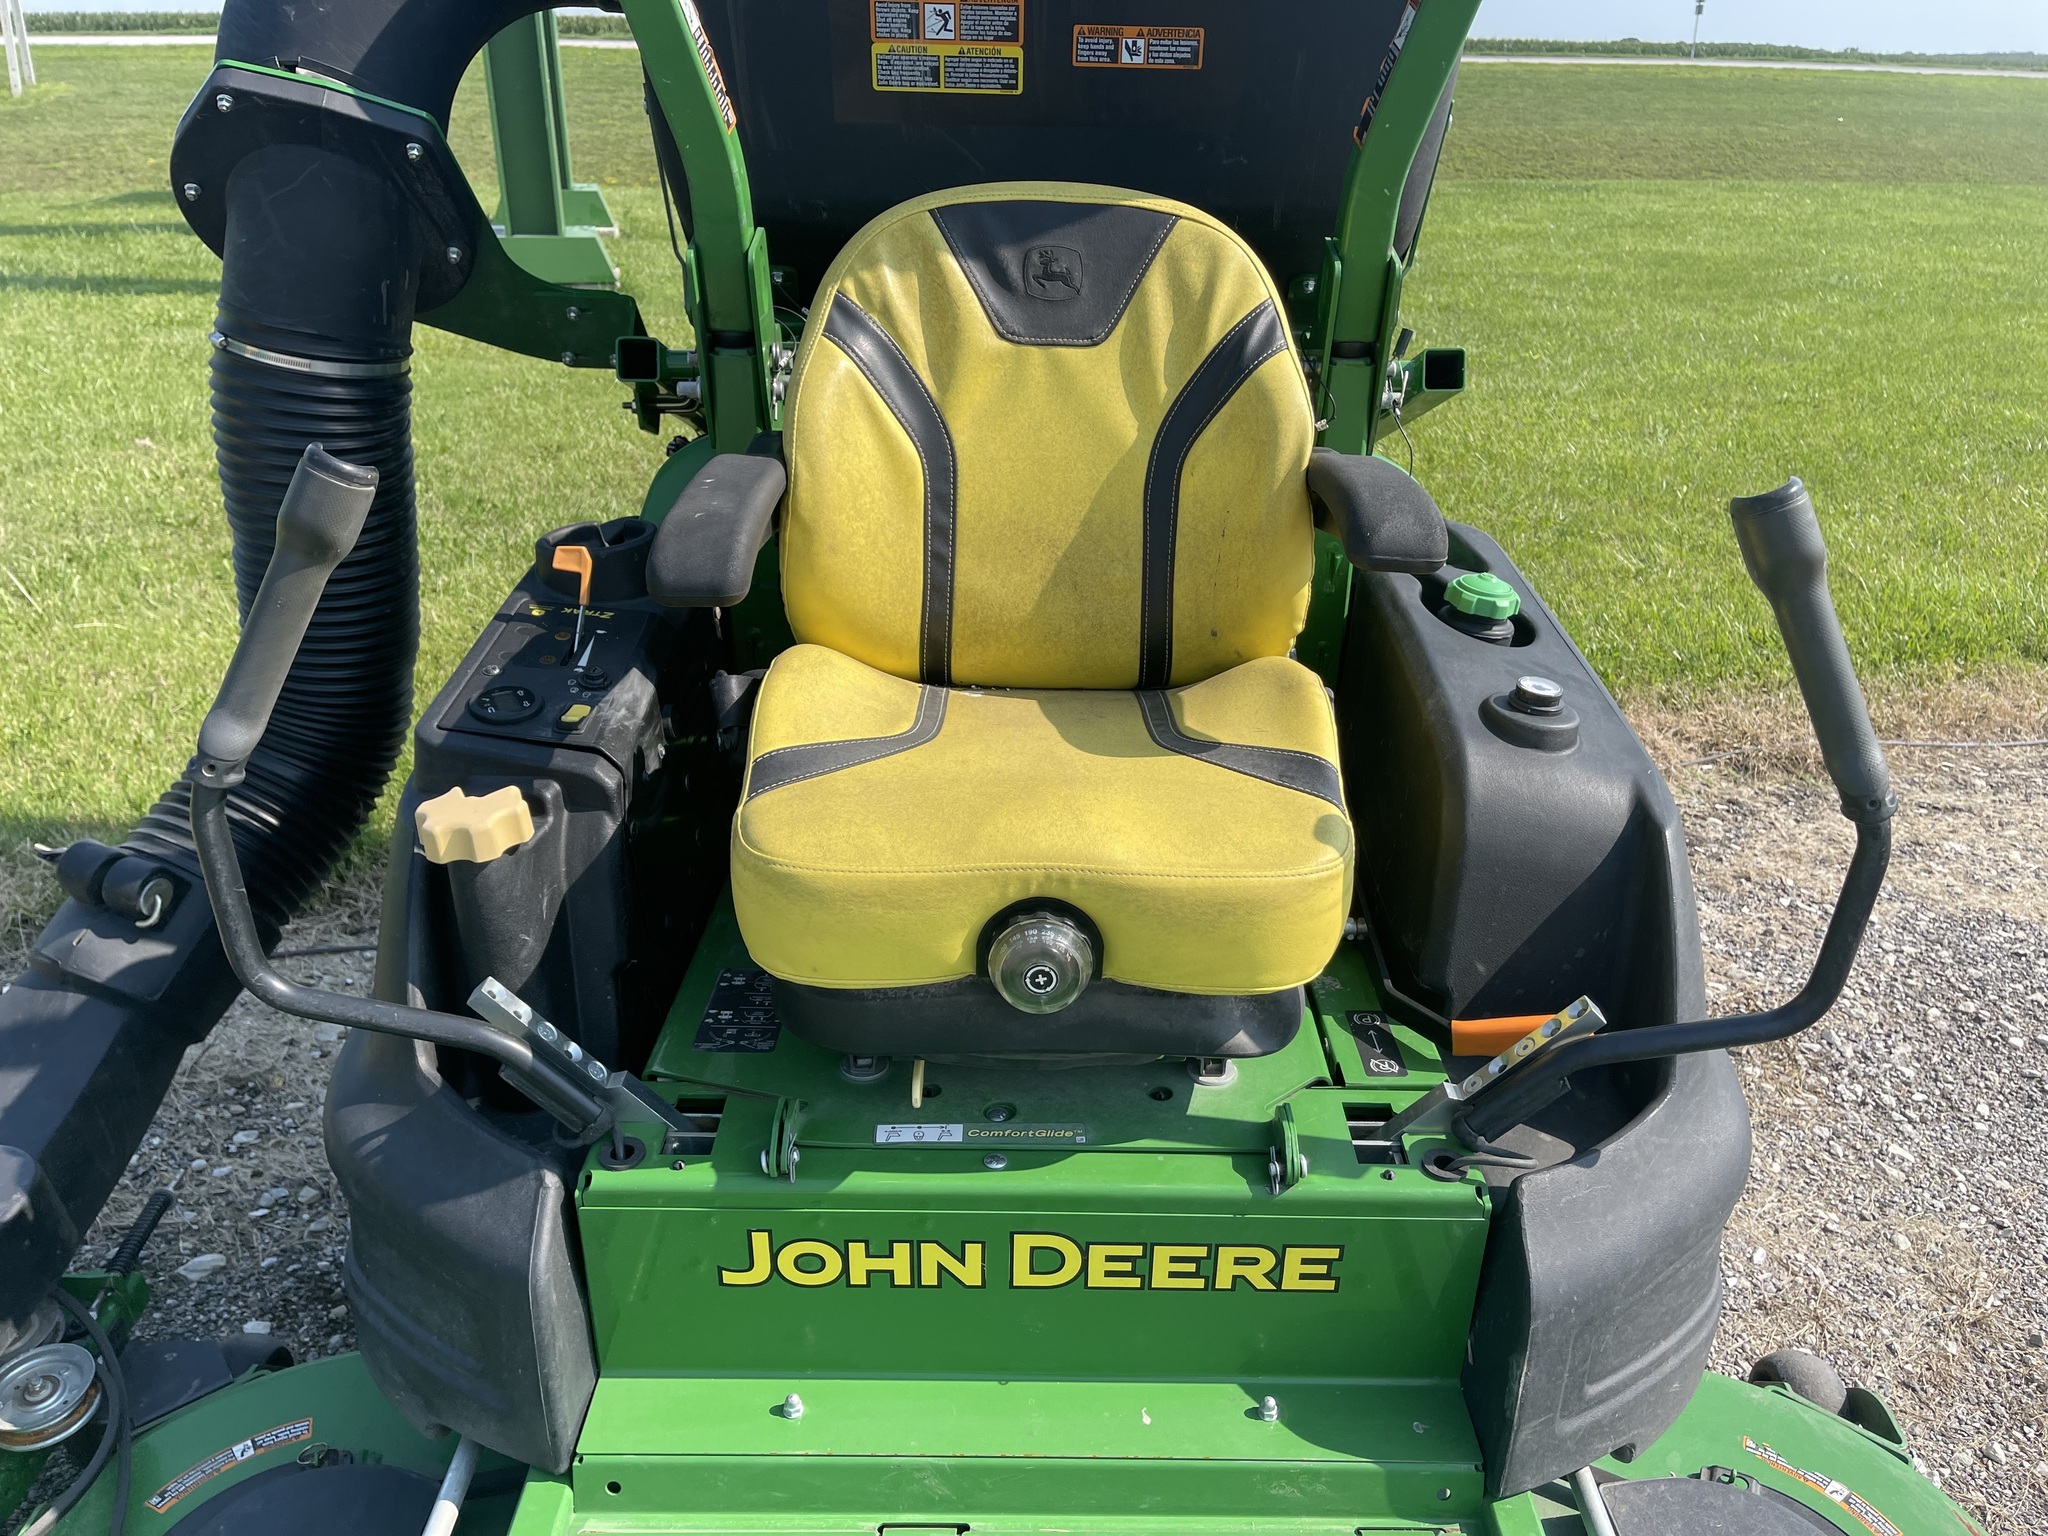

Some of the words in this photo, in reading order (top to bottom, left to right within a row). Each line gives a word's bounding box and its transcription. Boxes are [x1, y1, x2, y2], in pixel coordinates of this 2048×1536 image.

[1087, 26, 1124, 36] WARNING
[1146, 28, 1200, 38] ADVERTENCIA
[967, 46, 1001, 55] ATENCIÓN
[718, 1229, 987, 1289] JOHN
[1009, 1230, 1345, 1293] DEERE
